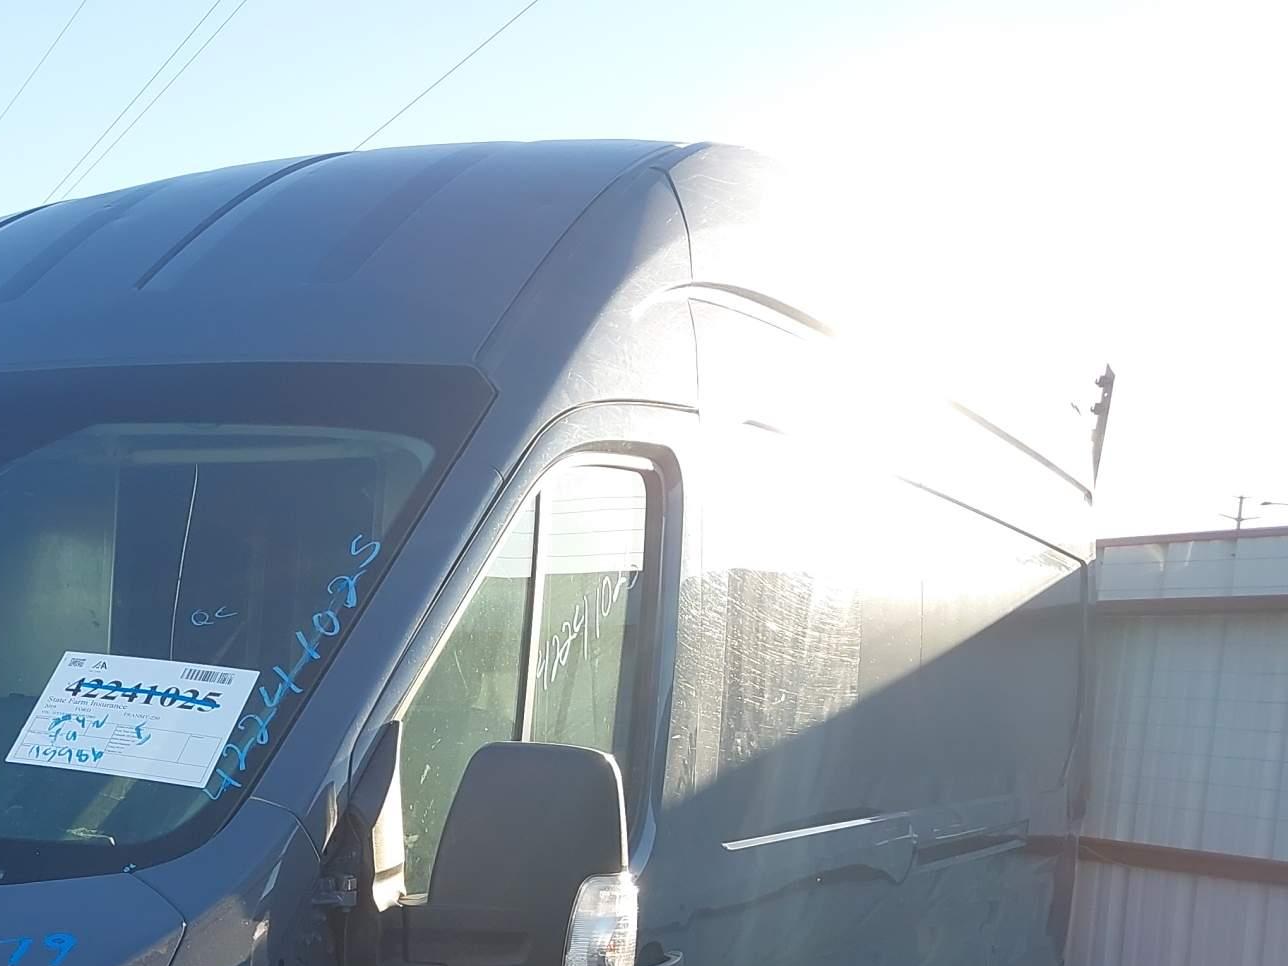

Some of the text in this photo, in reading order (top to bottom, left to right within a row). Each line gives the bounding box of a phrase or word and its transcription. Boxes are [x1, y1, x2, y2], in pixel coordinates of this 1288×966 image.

[201, 534, 381, 800] 42241025
[48, 695, 67, 704] State
[90, 701, 129, 710] Insurance
[65, 677, 223, 713] 42241025
